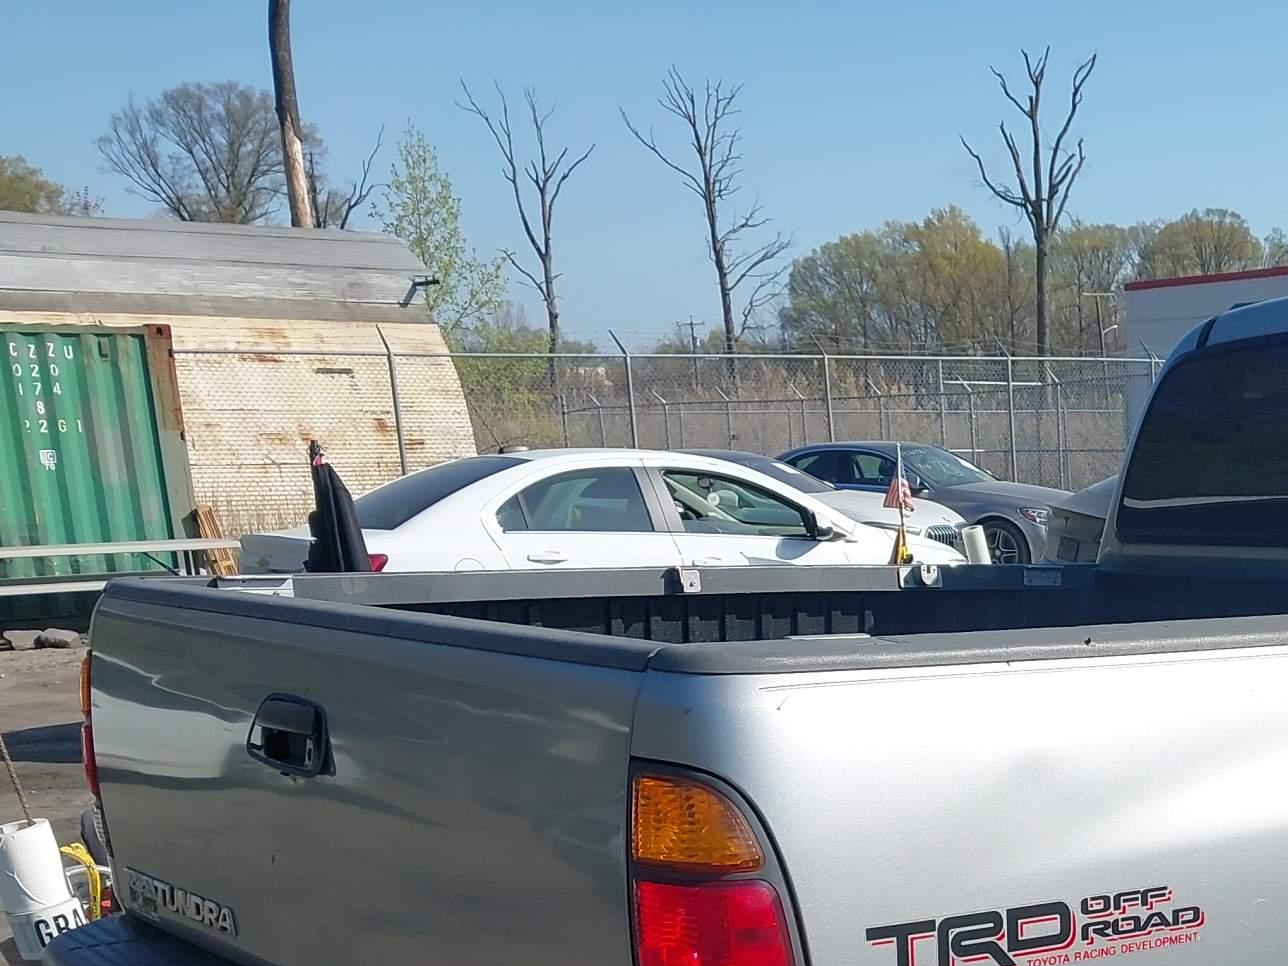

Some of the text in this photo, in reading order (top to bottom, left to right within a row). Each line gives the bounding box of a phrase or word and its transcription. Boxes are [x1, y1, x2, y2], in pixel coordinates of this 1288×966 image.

[36, 400, 45, 414] 8
[153, 879, 238, 938] TUNDRA
[1080, 885, 1173, 919] OFF
[1080, 905, 1205, 946] ROAD
[1073, 945, 1118, 962] RACING
[1120, 931, 1199, 955] DEVELOPMENT
